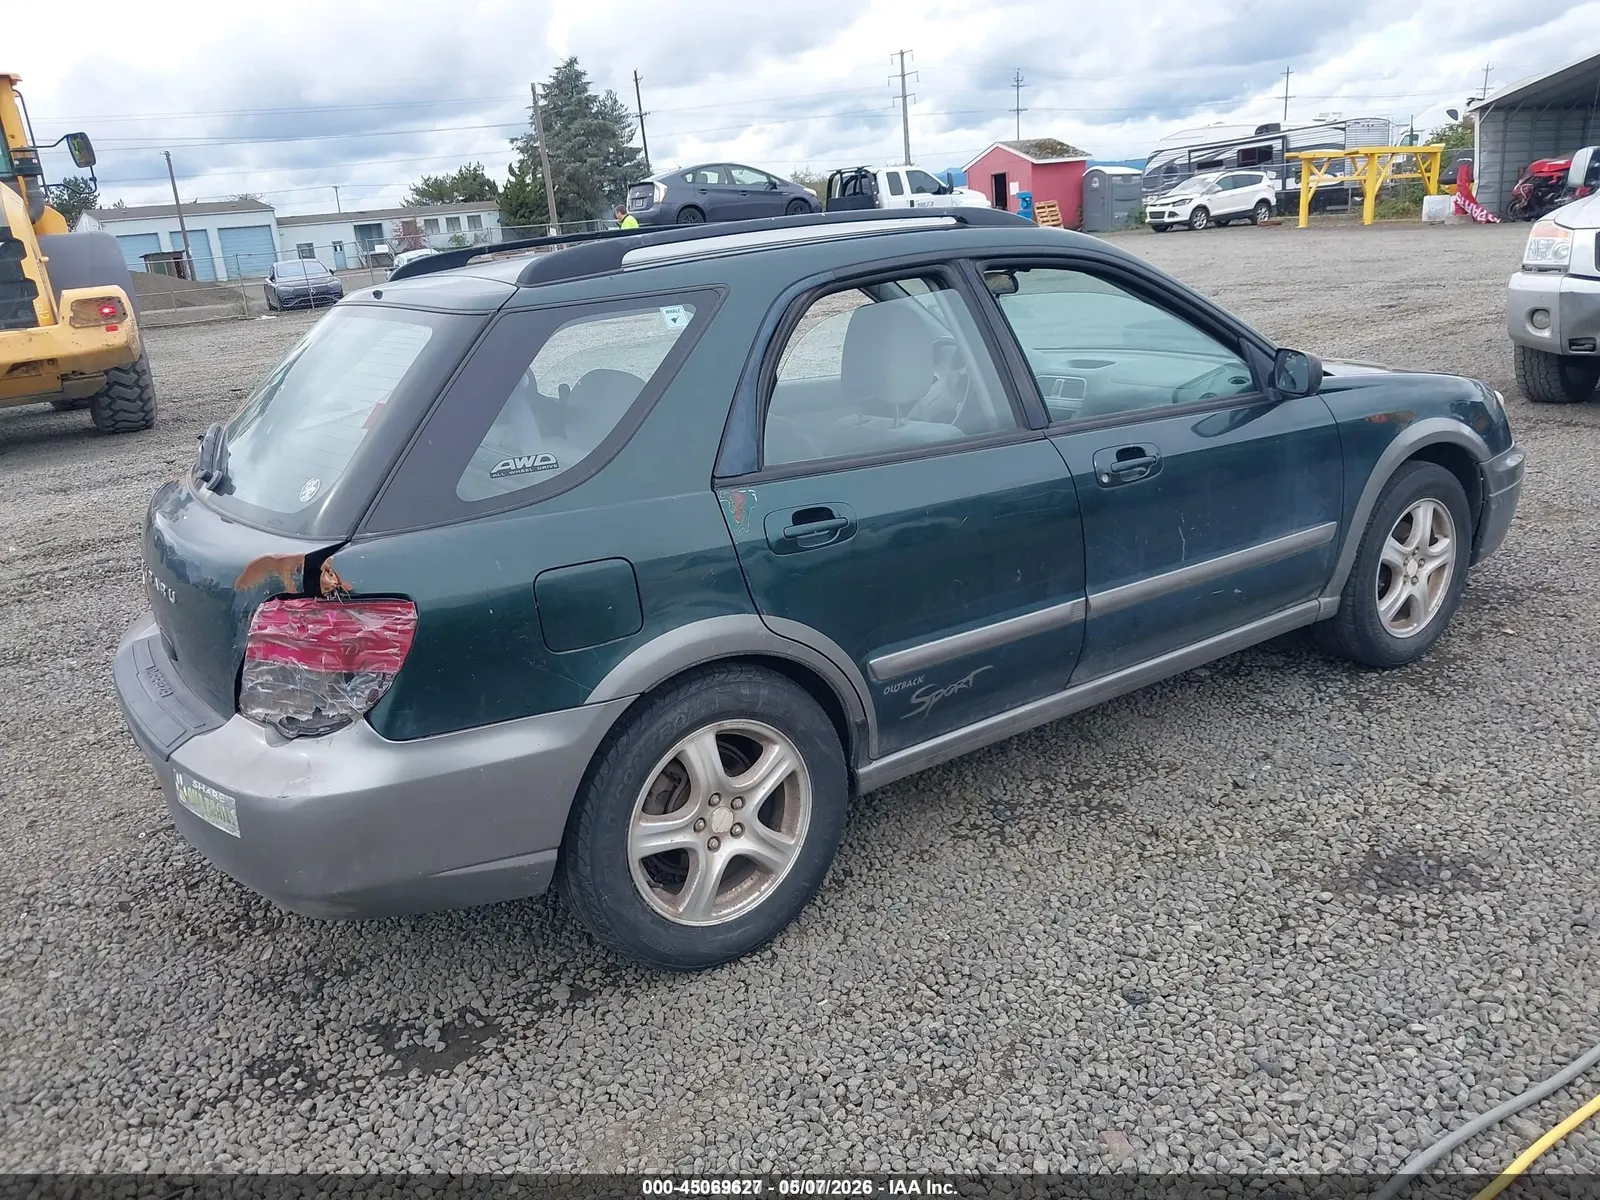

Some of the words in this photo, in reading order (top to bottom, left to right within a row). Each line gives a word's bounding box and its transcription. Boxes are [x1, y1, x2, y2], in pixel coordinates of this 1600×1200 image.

[490, 454, 557, 474] AWD
[883, 675, 925, 695] OUTBACK
[192, 780, 226, 803] SHARE
